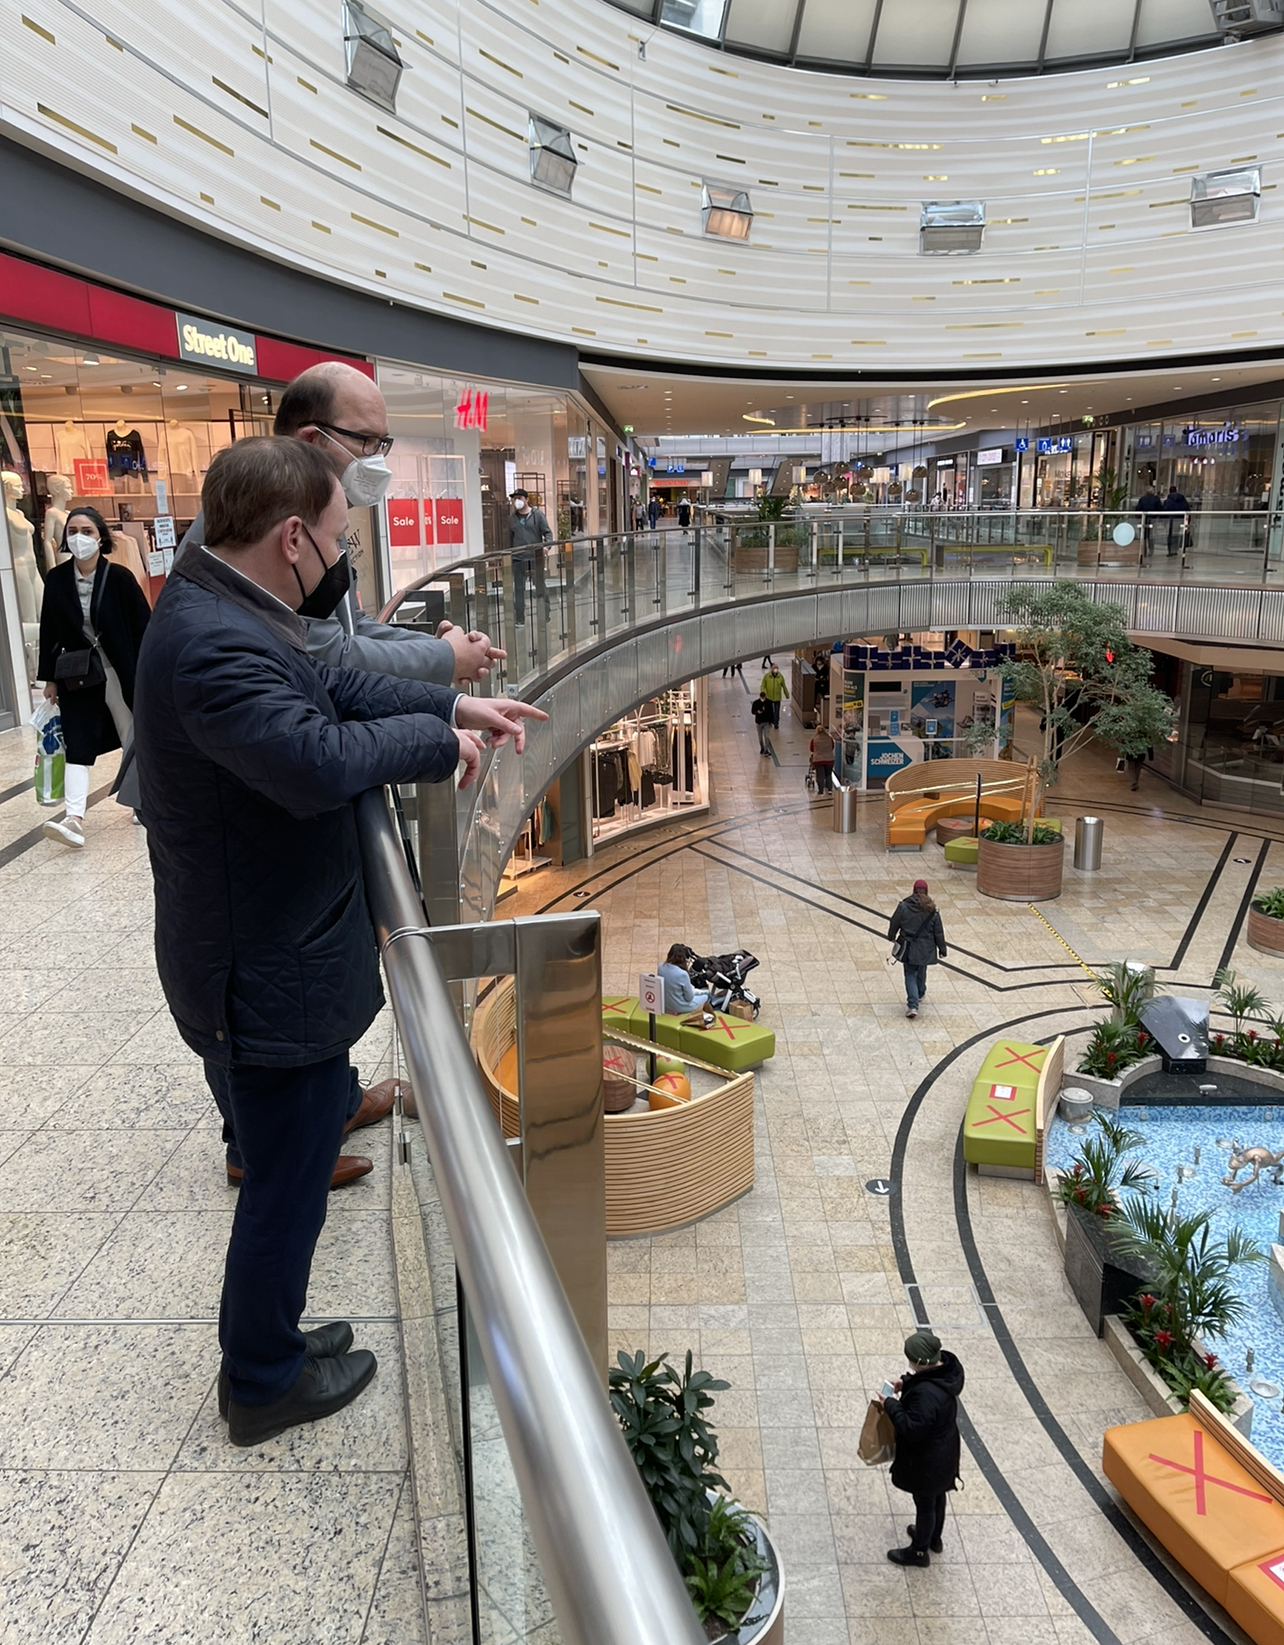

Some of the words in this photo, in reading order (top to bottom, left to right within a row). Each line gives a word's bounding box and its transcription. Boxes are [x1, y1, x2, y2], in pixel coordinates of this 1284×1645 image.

[183, 324, 228, 360] Street
[227, 336, 255, 366] One
[393, 516, 415, 526] Sale
[440, 515, 459, 525] Sale
[880, 752, 904, 760] JOCHEN
